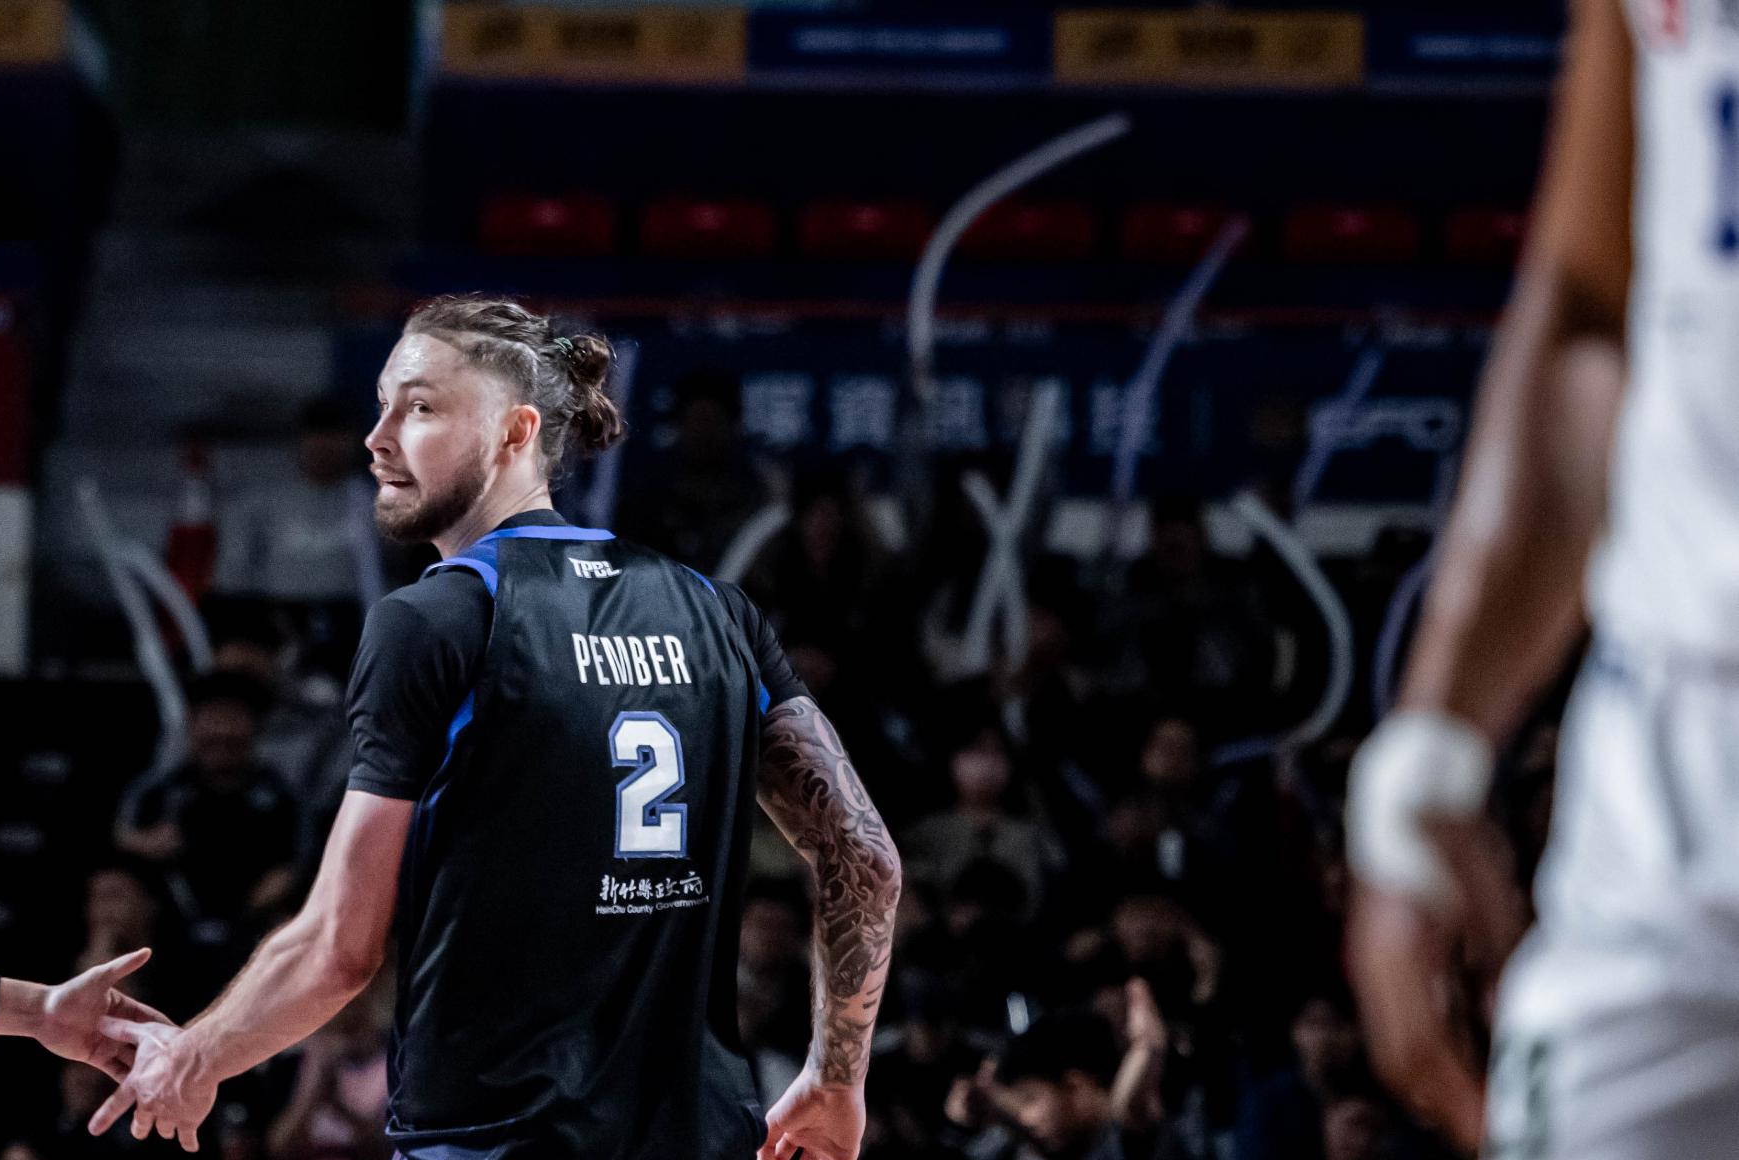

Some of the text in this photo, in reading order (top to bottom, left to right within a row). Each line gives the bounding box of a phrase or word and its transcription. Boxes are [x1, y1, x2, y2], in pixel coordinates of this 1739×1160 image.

[568, 557, 622, 579] TPBL
[571, 633, 692, 687] PEMBER
[608, 711, 687, 859] 2
